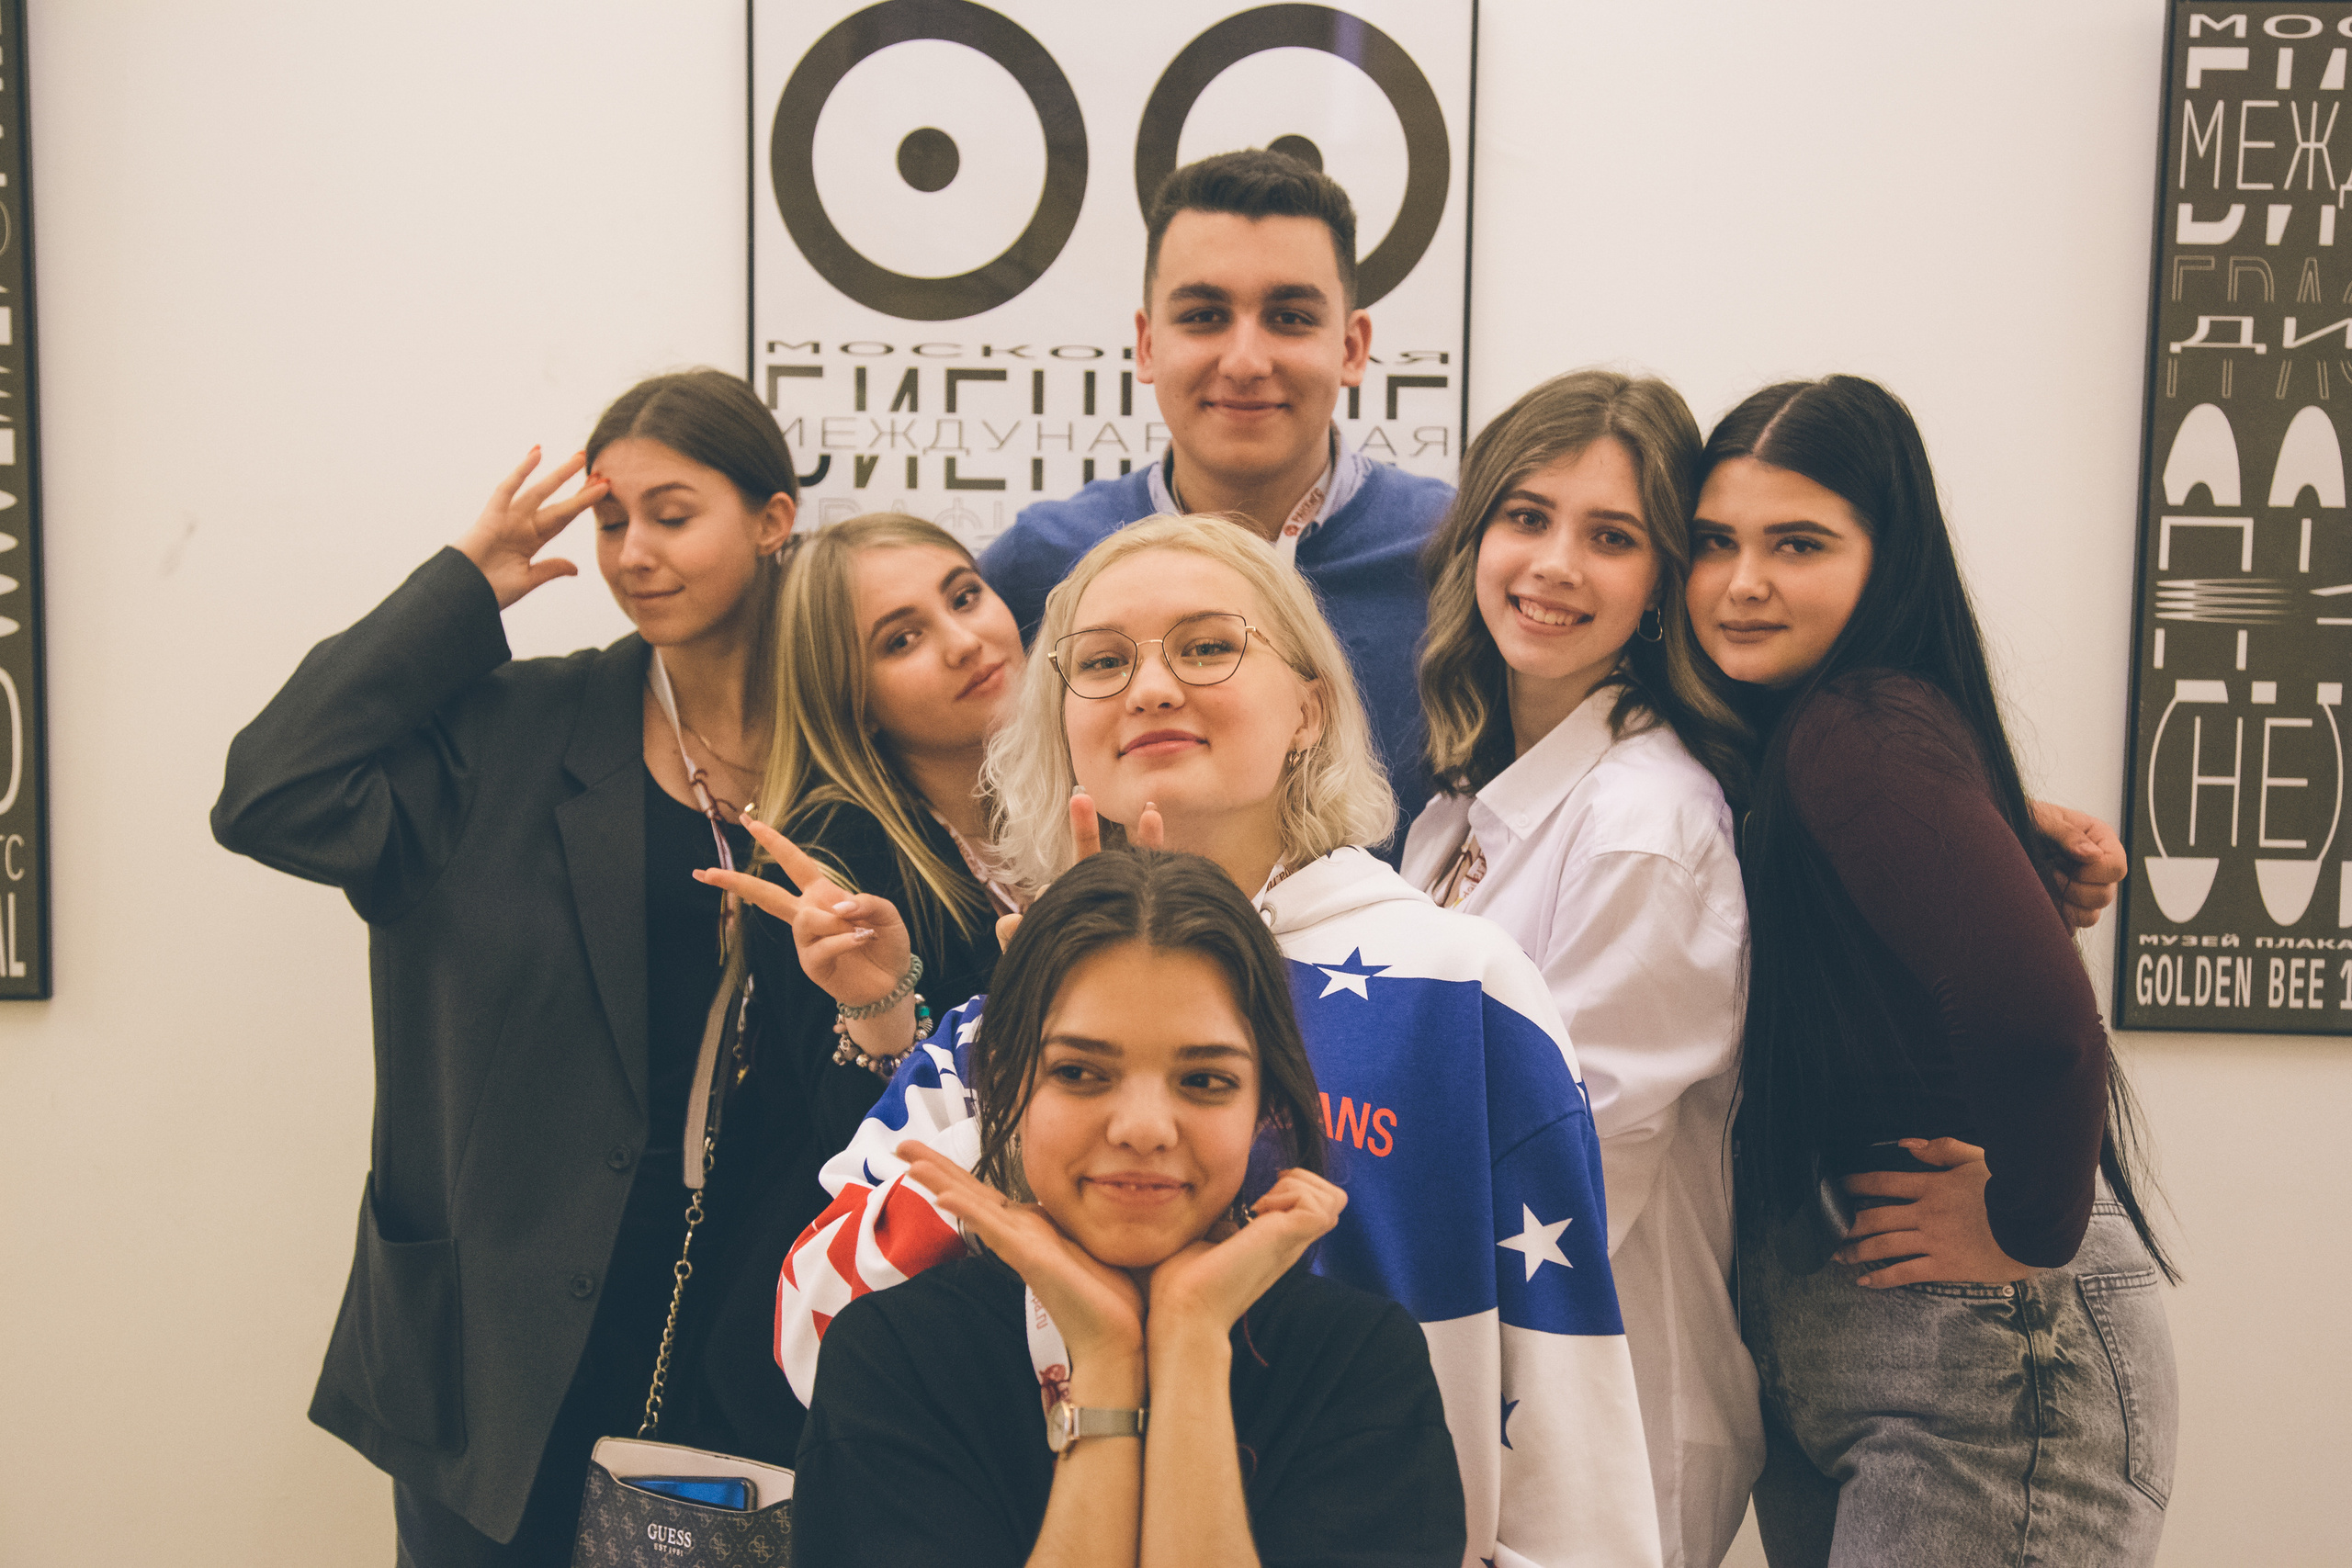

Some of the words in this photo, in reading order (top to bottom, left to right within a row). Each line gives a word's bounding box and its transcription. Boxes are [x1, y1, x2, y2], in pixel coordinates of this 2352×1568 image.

[2188, 14, 2352, 39] МО
[2178, 99, 2352, 209] МЕЖ
[2139, 933, 2240, 948] МУЗЕЙ
[2135, 953, 2252, 1009] GOLDEN
[2268, 956, 2326, 1010] BEE
[647, 1523, 692, 1548] GUESS
